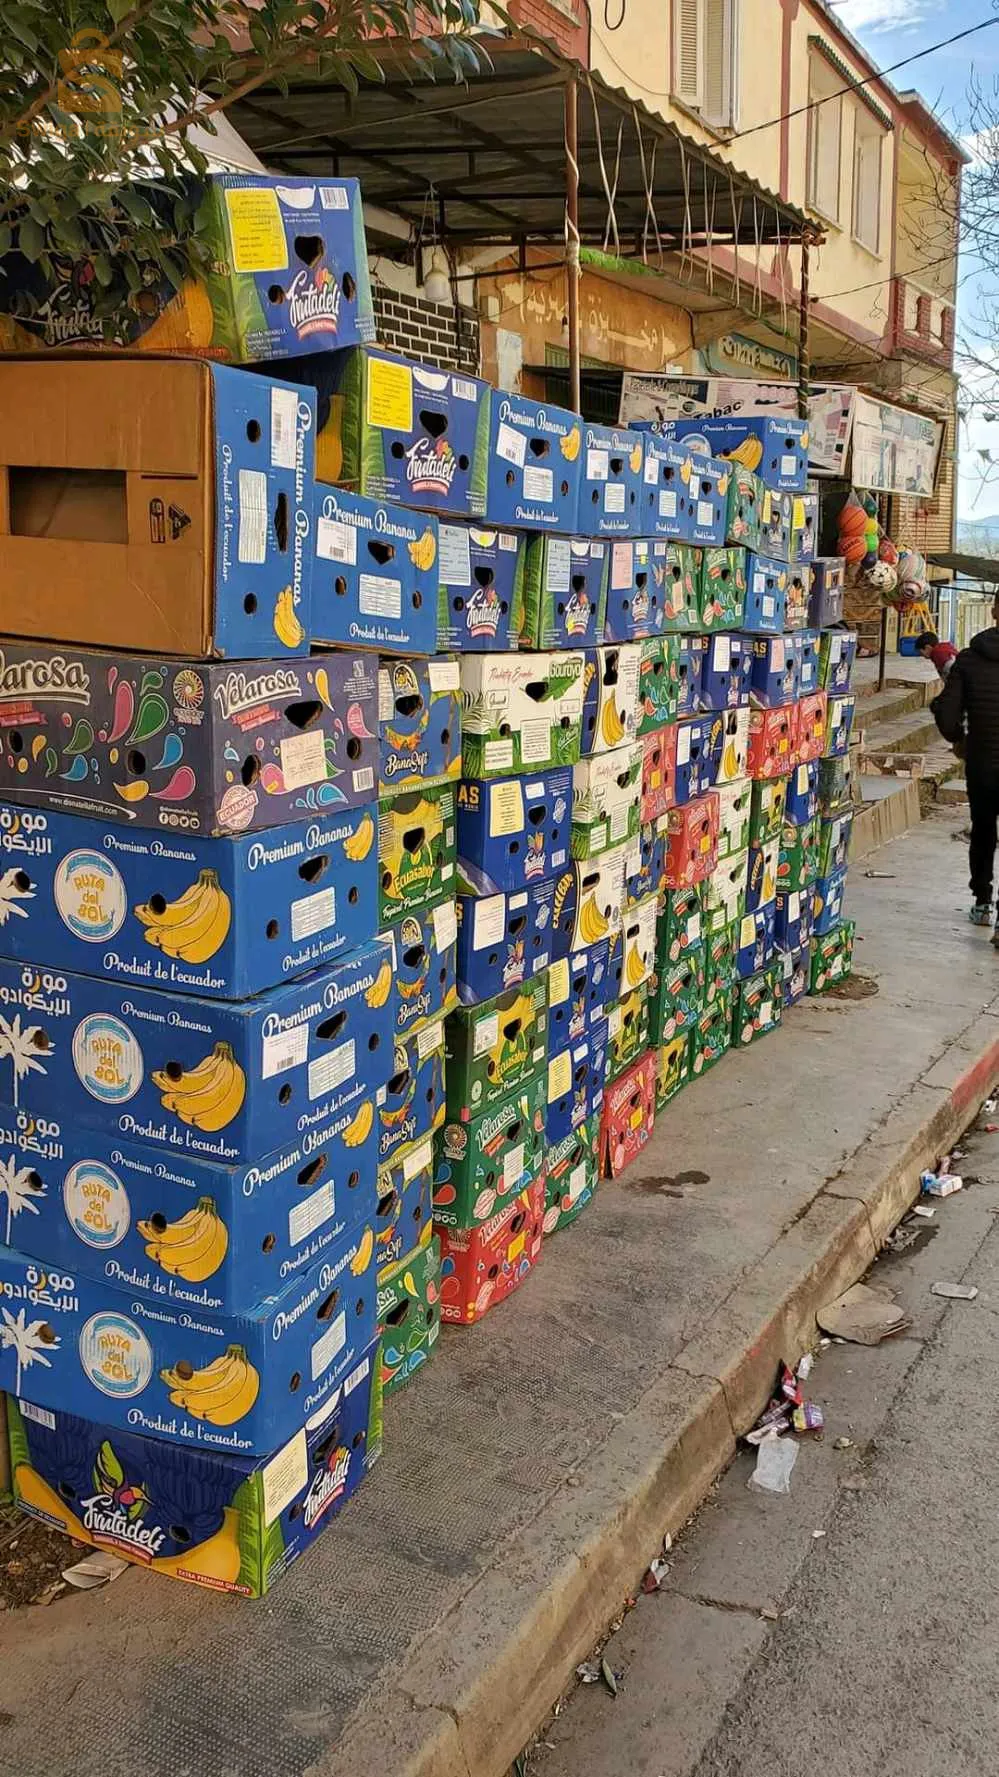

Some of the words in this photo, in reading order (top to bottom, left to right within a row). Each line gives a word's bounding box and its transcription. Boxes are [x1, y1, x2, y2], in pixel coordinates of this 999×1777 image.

[499, 400, 536, 429] Premium
[536, 410, 568, 436] Bananas
[294, 401, 312, 505] Premium
[222, 443, 233, 504] Produit
[322, 495, 373, 529] Premium
[374, 508, 418, 540] Bananas
[293, 509, 310, 606] Bananas
[349, 622, 376, 640] Produit
[219, 796, 256, 820] ECUADOR
[457, 784, 480, 805] AS
[0, 808, 48, 834] موزة
[103, 834, 149, 856] Premium
[150, 841, 196, 861] Bananas
[247, 839, 305, 871] Premium
[305, 824, 354, 850] Bananas
[73, 872, 106, 891] RUTA
[82, 891, 99, 905] del
[78, 904, 108, 922] SOL
[103, 952, 152, 977] Produit
[153, 962, 169, 980] de
[170, 963, 226, 989] l'ecuador
[282, 946, 310, 972] Produit
[22, 967, 68, 995] موزة
[120, 1001, 166, 1024] Premium
[167, 1011, 213, 1034] Bananas
[262, 1003, 323, 1040] Premium
[323, 973, 375, 1009] Bananas
[90, 1036, 124, 1056] RUTA
[98, 1055, 117, 1069] del
[16, 1111, 60, 1138] موزة
[297, 1101, 330, 1131] Produit
[119, 1114, 168, 1142] Produit
[168, 1126, 184, 1146] de
[185, 1130, 240, 1159] l'ecuador
[111, 1150, 152, 1175] Premium
[152, 1162, 197, 1188] Bananas
[242, 1149, 301, 1197] Premium
[302, 1114, 353, 1156] Bananas
[80, 1183, 112, 1204] RUTA
[88, 1199, 105, 1213] del
[84, 1210, 112, 1231] SOL
[280, 1248, 310, 1278] Produit
[26, 1266, 75, 1292] موزة
[104, 1260, 151, 1288] Produit
[151, 1274, 166, 1294] de
[167, 1281, 224, 1309] l'ecuador
[272, 1287, 320, 1341] Premium
[318, 1245, 358, 1292] Bananas
[131, 1302, 177, 1325] Premium
[178, 1313, 225, 1336] Bananas
[99, 1334, 131, 1353] RUTA
[107, 1349, 125, 1364] del
[101, 1361, 134, 1381] SOL
[303, 1382, 328, 1413] Produit
[128, 1408, 180, 1435] Produit
[180, 1417, 195, 1438] de
[197, 1423, 252, 1449] l'ecuador
[80, 1494, 167, 1552] Frutadeli
[178, 1568, 196, 1581] EXTRA
[195, 1573, 225, 1588] PREMIUM
[225, 1581, 251, 1594] QUALITY
